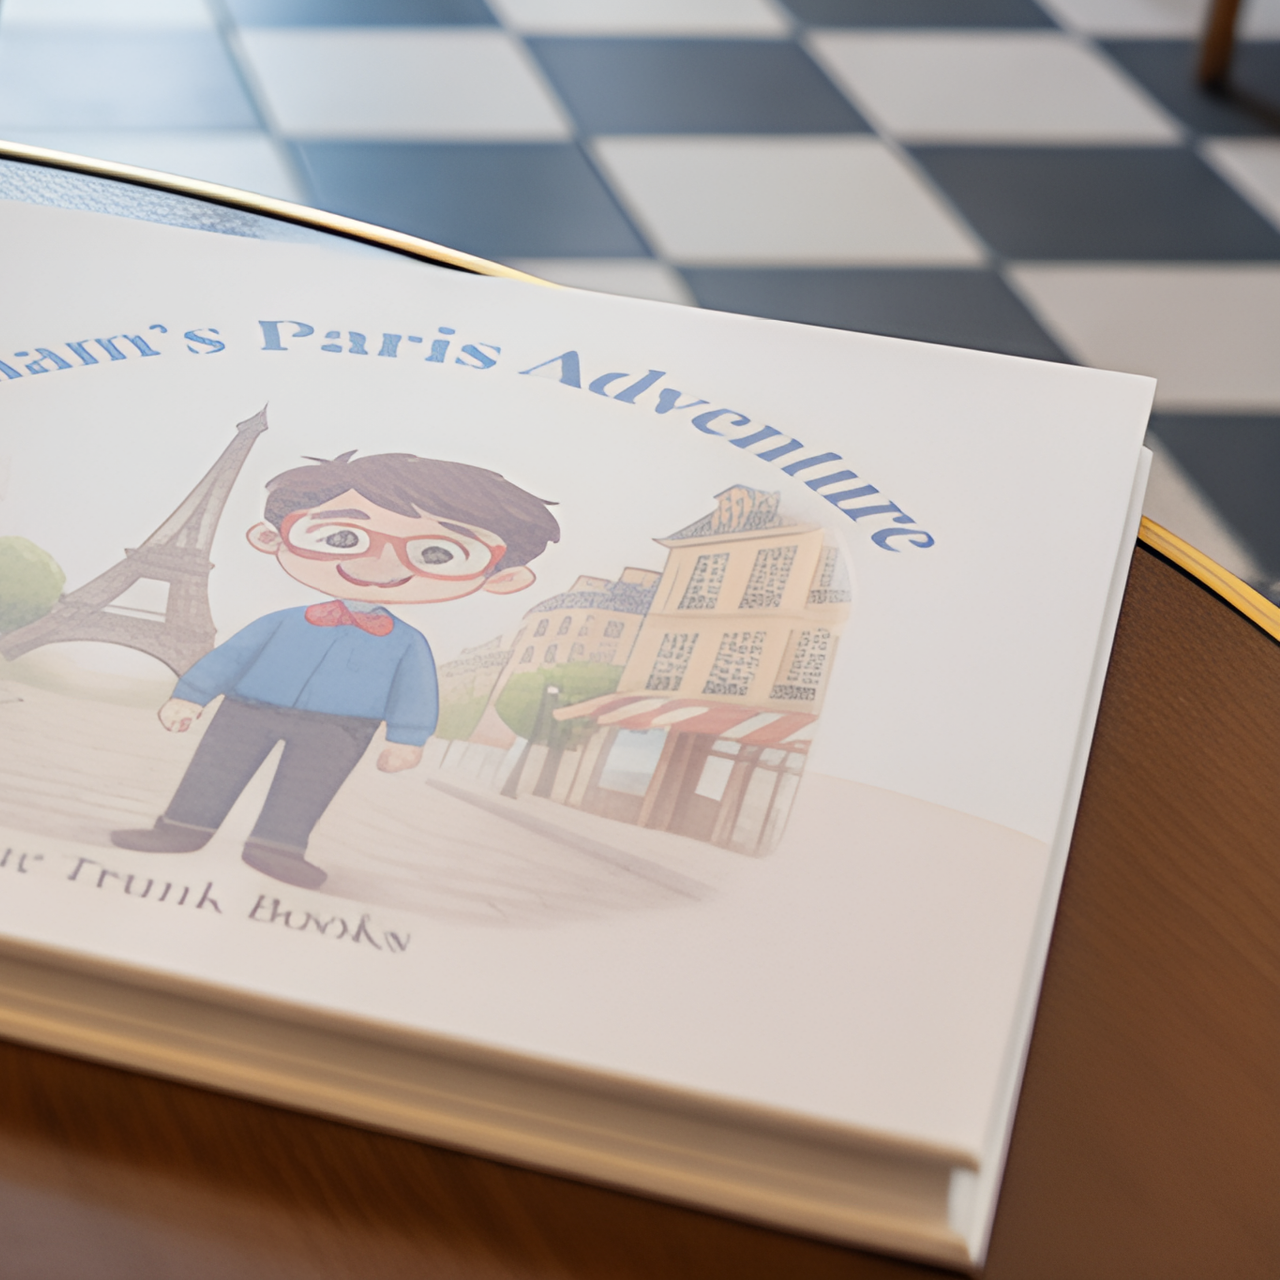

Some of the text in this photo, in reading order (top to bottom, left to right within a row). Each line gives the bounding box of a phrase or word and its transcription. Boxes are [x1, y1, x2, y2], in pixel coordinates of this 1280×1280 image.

[257, 319, 502, 370] Paris
[517, 349, 936, 554] Adventure
[62, 854, 224, 915] Trunk
